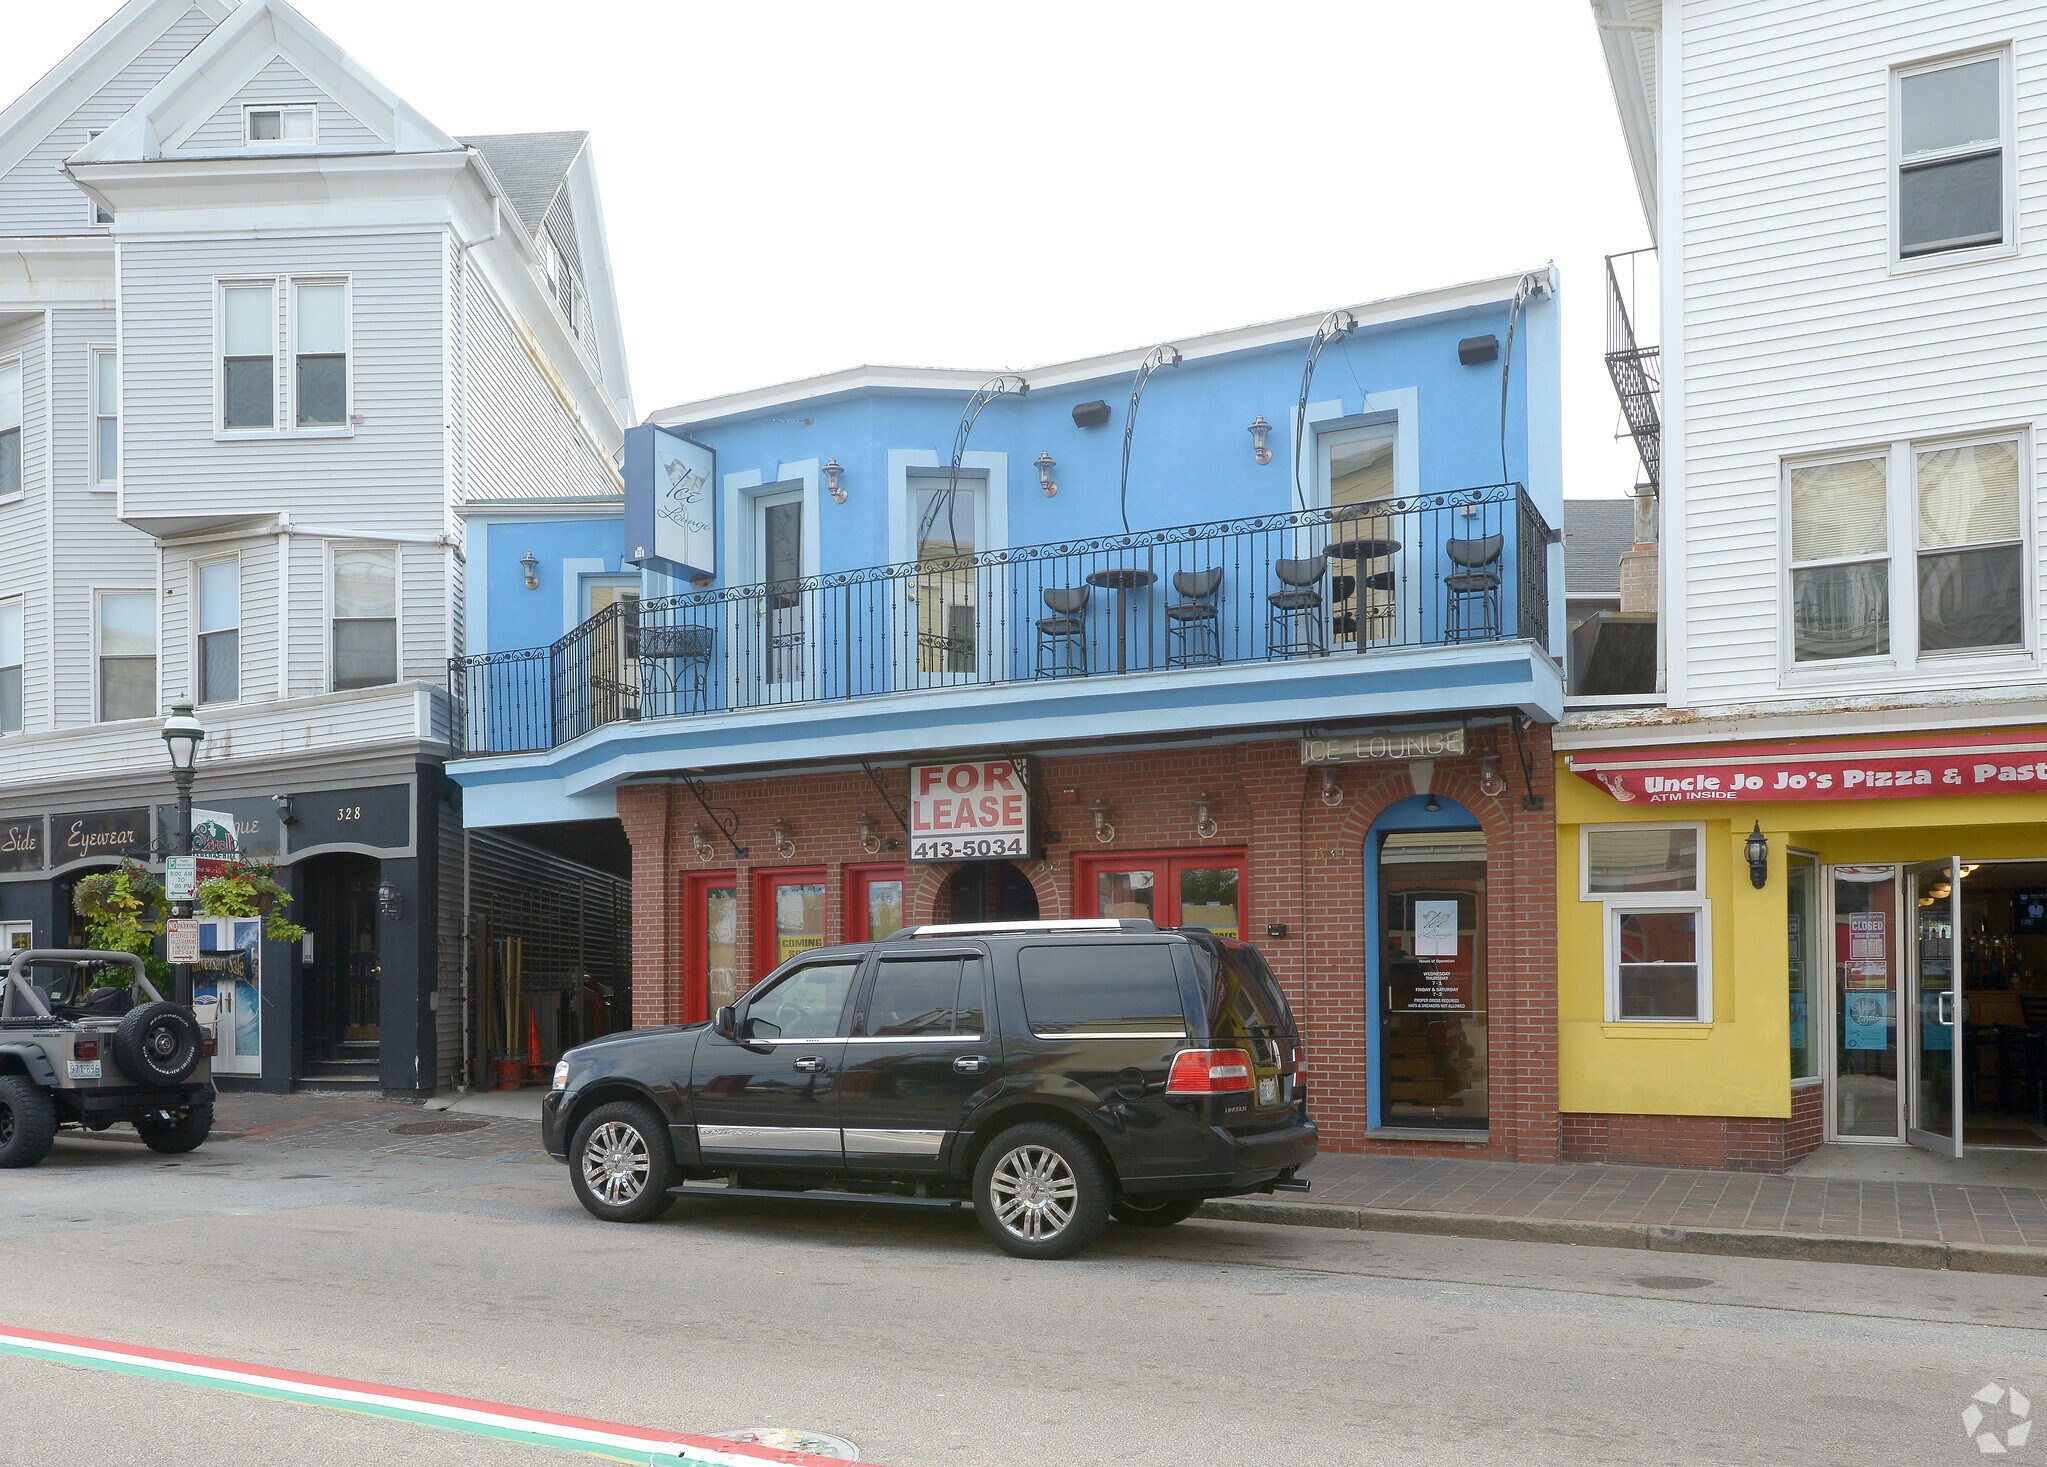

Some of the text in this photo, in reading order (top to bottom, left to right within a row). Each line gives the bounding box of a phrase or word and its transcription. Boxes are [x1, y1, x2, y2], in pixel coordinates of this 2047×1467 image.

[656, 505, 711, 533] Lounge
[1305, 732, 1462, 762] ICE LOUNGE
[919, 762, 1015, 796] FOR
[1644, 774, 1721, 793] Uncle
[1730, 773, 1764, 790] Jo
[1773, 771, 1833, 790] Jo's
[1843, 769, 1932, 788] Pizza
[1942, 768, 1962, 785] &
[1650, 791, 1738, 803] ATM INSIDE
[337, 806, 361, 821] 328
[913, 795, 1023, 831] LEASE
[1, 824, 37, 852] Side
[67, 820, 135, 857] Eyewear
[914, 838, 1022, 858] 413-5034
[169, 921, 178, 931] NO
[1851, 921, 1883, 931] CLOSED
[782, 938, 822, 948] COMING
[228, 954, 245, 977] Sale
[700, 1128, 761, 1136] NAVIGATOR
